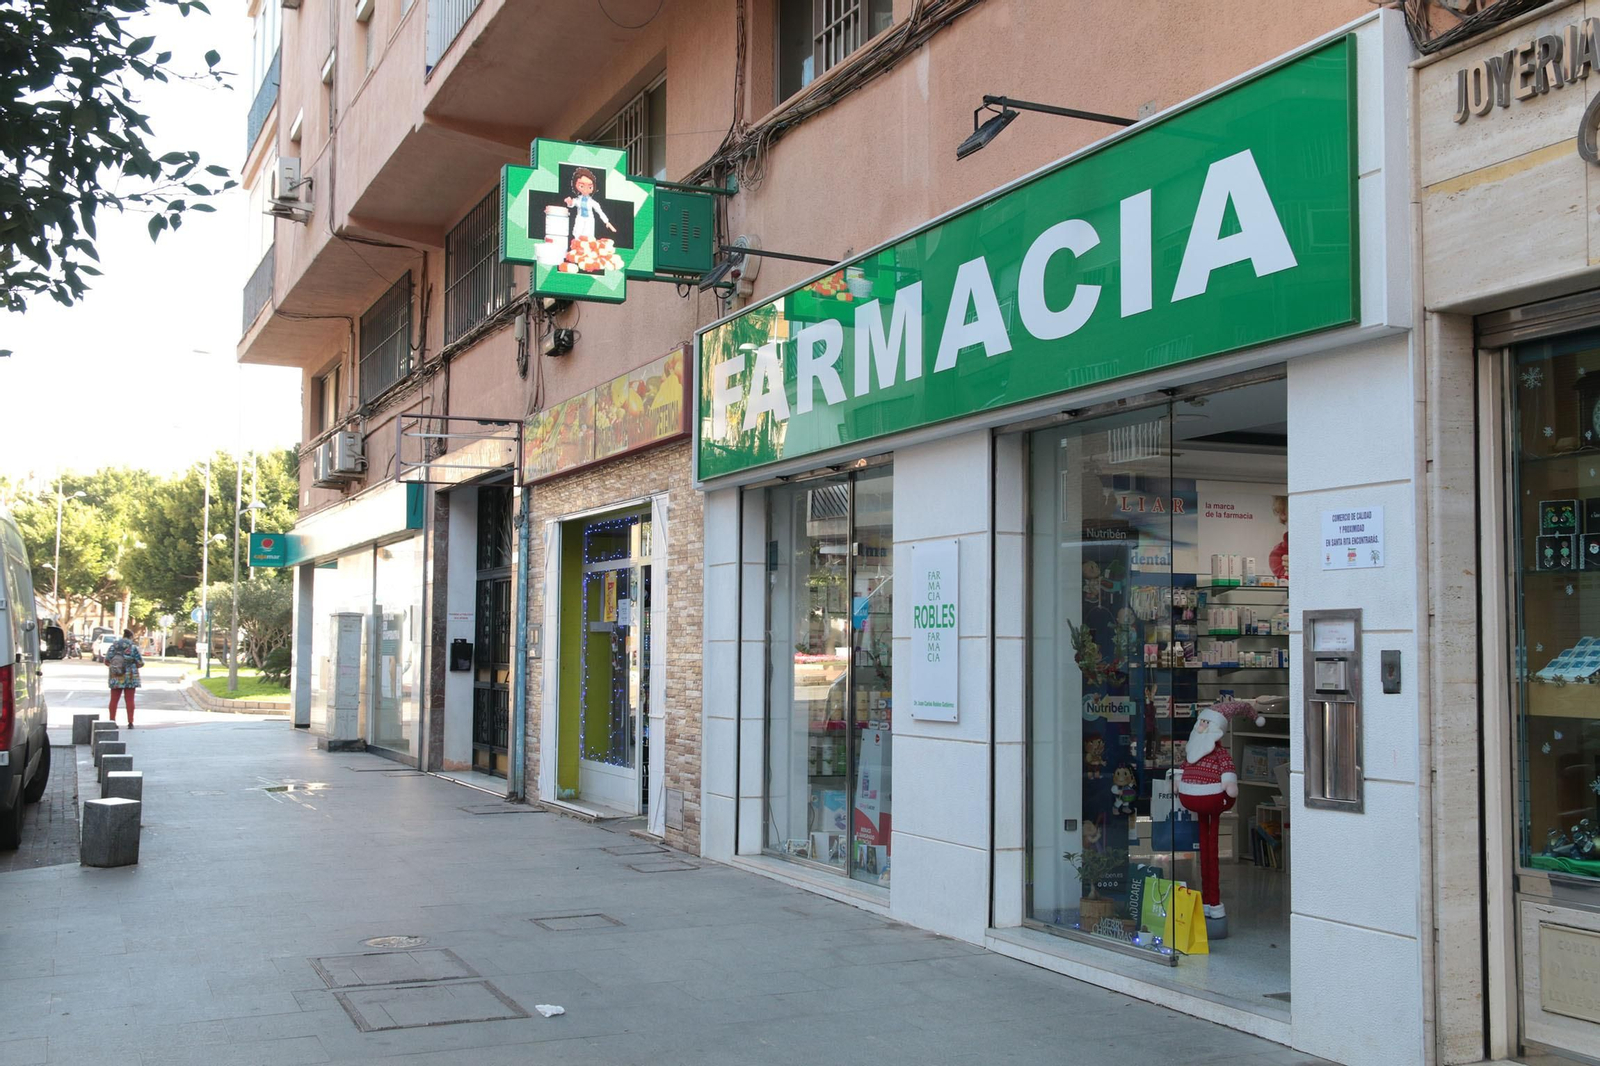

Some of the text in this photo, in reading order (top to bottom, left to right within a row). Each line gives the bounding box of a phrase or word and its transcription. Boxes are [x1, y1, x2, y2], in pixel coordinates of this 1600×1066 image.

[1453, 17, 1600, 124] JOYERIA
[712, 149, 1299, 441] FARMACIA
[1205, 502, 1212, 510] la
[1215, 511, 1222, 519] la
[1223, 511, 1254, 520] farmacia
[1332, 511, 1372, 522] COMERCIO DE CALIDAD
[1086, 528, 1127, 539] Nutribén
[1339, 524, 1364, 534] Y PROXIMIDAD
[1325, 539, 1331, 547] EN
[1331, 538, 1342, 547] SANTA
[1343, 537, 1351, 546] RITA
[1131, 551, 1171, 566] dental
[928, 571, 941, 580] FAR
[928, 581, 941, 591] MA
[928, 592, 941, 601] CIA
[914, 604, 956, 629] ROBLES
[927, 632, 940, 641] FAR
[927, 642, 940, 652] MA
[927, 653, 940, 662] CIA
[1086, 701, 1130, 714] Nutribén
[1129, 878, 1142, 922] NDOCARE
[1100, 917, 1124, 931] MERRY
[1092, 923, 1133, 942] CHRISTMAS
